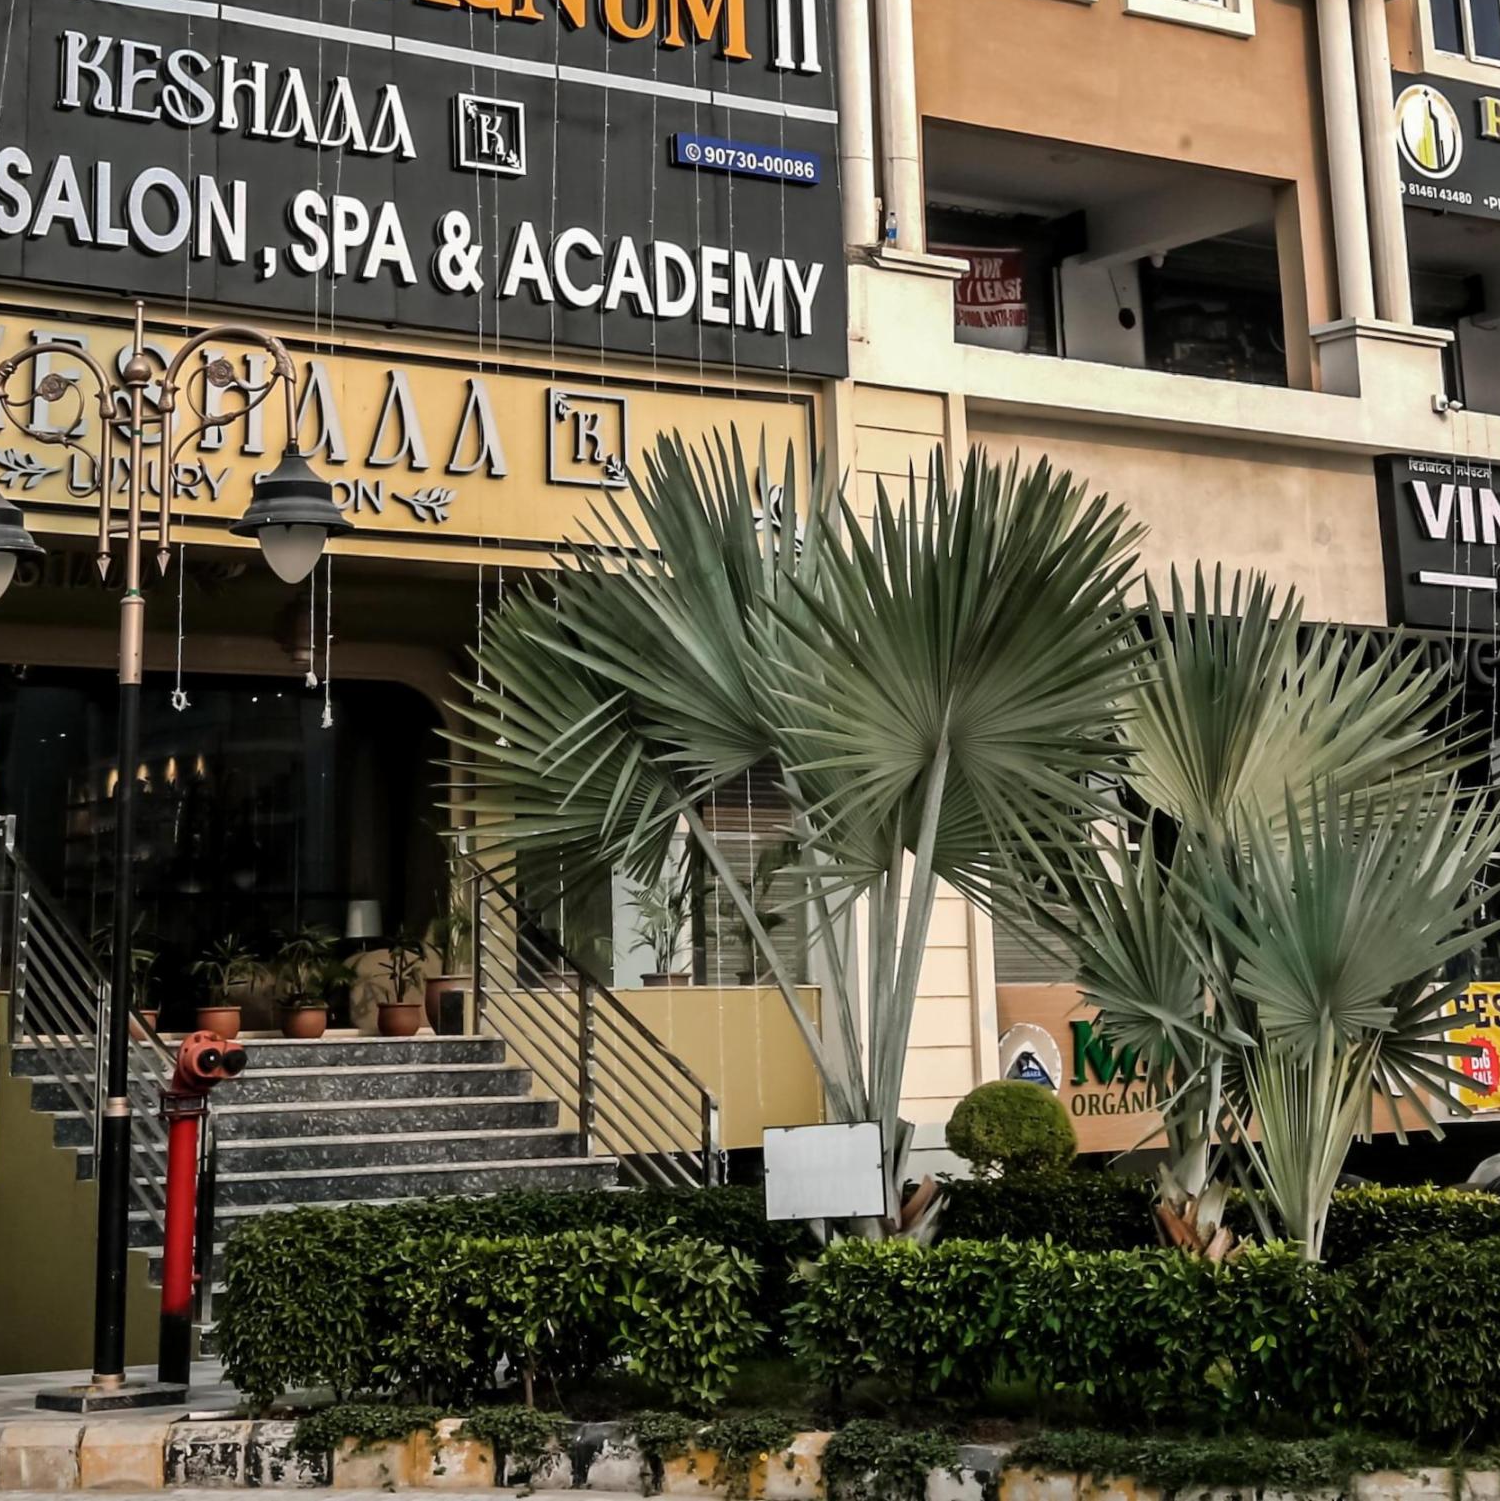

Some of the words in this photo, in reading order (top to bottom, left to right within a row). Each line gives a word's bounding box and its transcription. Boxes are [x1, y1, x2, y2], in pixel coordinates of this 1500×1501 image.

[703, 146, 816, 181] 90730-00086
[1408, 182, 1439, 200] 81461
[1439, 187, 1473, 206] 43480
[288, 189, 418, 286] SPA
[436, 209, 485, 296] &
[503, 219, 825, 337] ACADEMY
[1071, 1092, 1151, 1117] ORGAN
